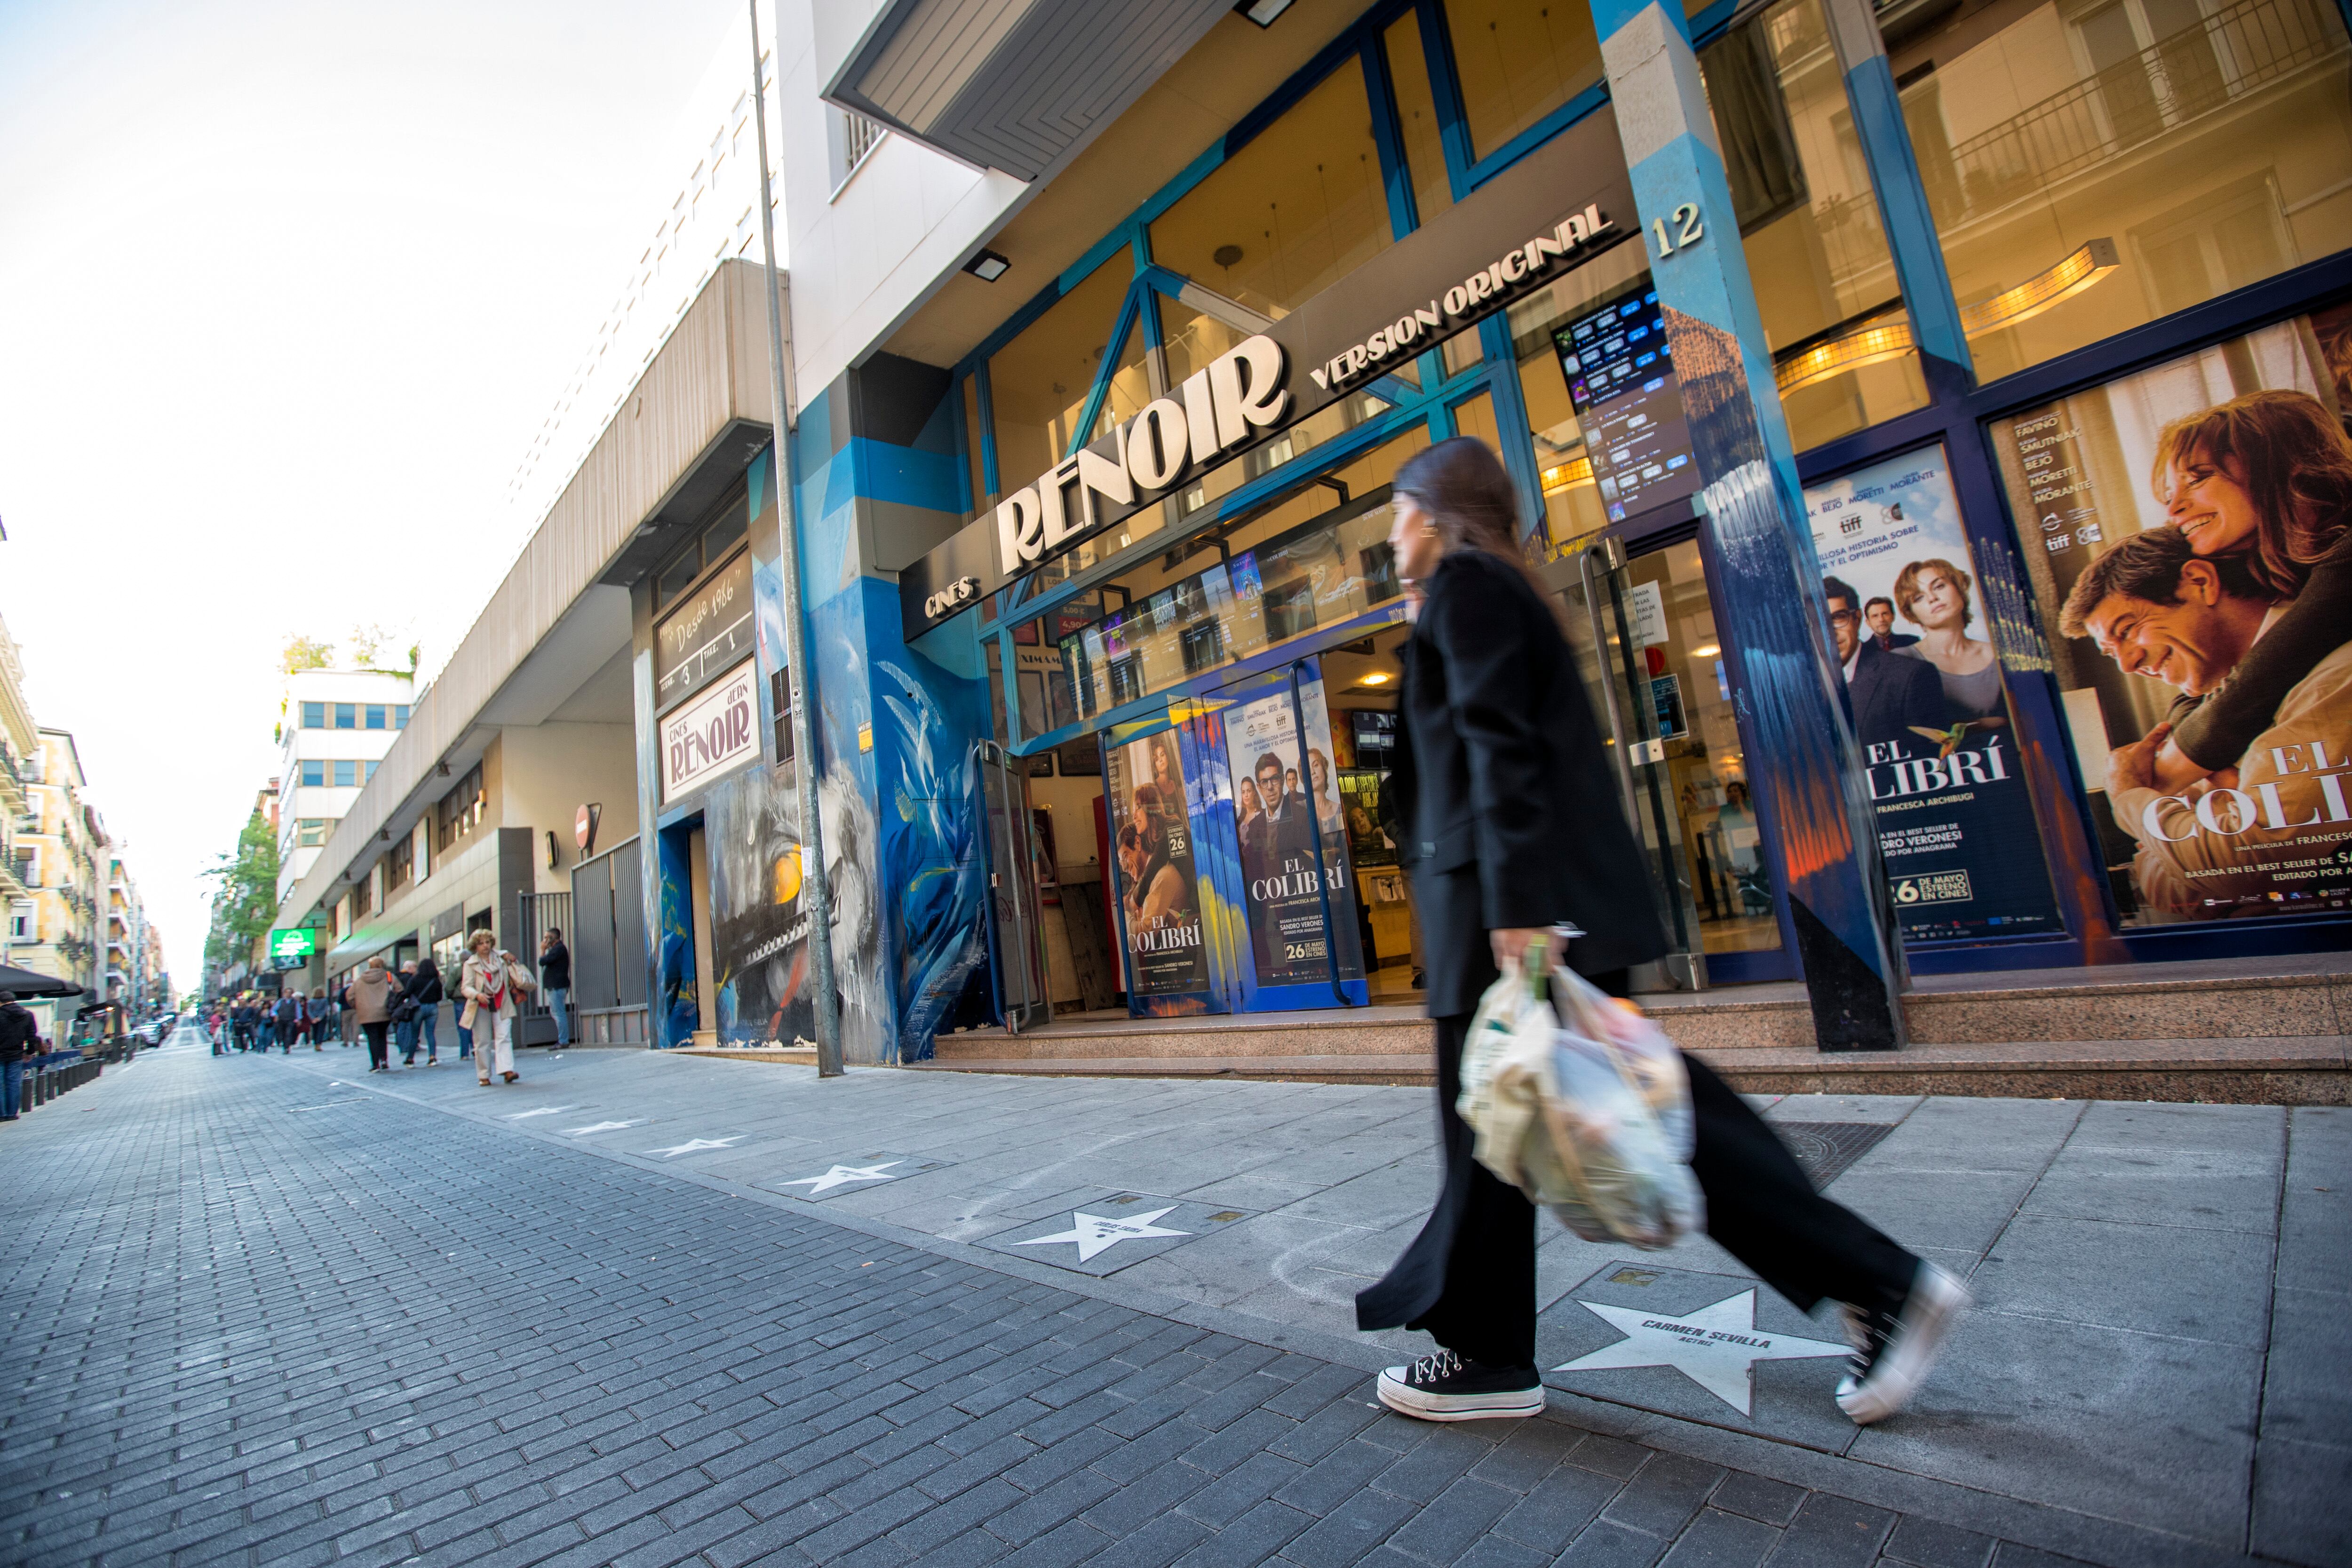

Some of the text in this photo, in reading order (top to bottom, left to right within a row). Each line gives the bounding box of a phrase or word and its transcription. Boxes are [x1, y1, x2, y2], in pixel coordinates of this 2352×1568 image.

[1652, 202, 1704, 259] 12
[1310, 204, 1613, 390] VERSION ORIGINAL
[2015, 417, 2059, 438] FAVINO
[2020, 428, 2082, 454] SMUTNIAK
[997, 334, 1288, 575] RENOIR
[2024, 455, 2054, 471] BEJO
[2030, 466, 2079, 488] MORETTI
[1822, 470, 1935, 513] BEJO MORETTI MORANTE
[2034, 480, 2093, 505] MORANTE
[1840, 515, 1862, 533] tiff
[1818, 525, 1919, 561] ILLOSA HISTORIA SOBRE
[1849, 541, 1899, 562] OPTIMISMO
[2046, 534, 2070, 552] tiff
[925, 576, 973, 618] CINES
[729, 631, 736, 651] 1
[681, 665, 690, 685] 3
[1247, 710, 1267, 720] SMUTNIAK
[1276, 715, 1287, 727] tiff
[669, 721, 688, 742] CINES
[1253, 734, 1279, 746] MARAVILLOSA
[1279, 736, 1298, 745] OPTIMISM
[670, 700, 750, 784] RENOIR
[1866, 739, 1912, 766] EL
[2266, 740, 2351, 776] EL
[1865, 734, 2011, 801] LIBRÍ
[1357, 774, 1379, 792] ESPECIES
[1362, 791, 1379, 808] ABEJA
[1875, 792, 1975, 814] FRANCESCA ARCHIBUGI
[2142, 772, 2352, 842] COLI
[1906, 828, 1923, 836] BEST
[1923, 824, 1948, 834] SELLER
[1948, 822, 1959, 831] DE
[1170, 837, 1185, 851] 26
[1881, 830, 1963, 850] DRO VERONESI
[1897, 847, 1913, 856] POR
[1913, 842, 1958, 853] ANAGRAMA
[1284, 858, 1304, 873] EL
[2185, 868, 2226, 879] BASADA
[2257, 862, 2282, 871] BEST
[2282, 859, 2317, 869] SELLER
[2319, 857, 2334, 865] DE
[2272, 871, 2318, 881] EDITADO
[2319, 868, 2344, 877] POR
[1252, 859, 1346, 901] COLIBRÍ
[1917, 877, 1931, 885] DE
[1933, 874, 1965, 883] MAYO
[1919, 881, 1966, 893] ESTRENO
[1288, 898, 1310, 906] FRANCESCA
[1921, 888, 1969, 900] EN CINES
[1152, 915, 1168, 929] EL
[1280, 919, 1324, 931] SANDRO VERONES
[1127, 918, 1202, 954] COLIBRÍ
[1286, 944, 1305, 959] 26
[1641, 1319, 1772, 1349] CARMEN SEVILLA
[1677, 1336, 1715, 1347] ACTRIZ
